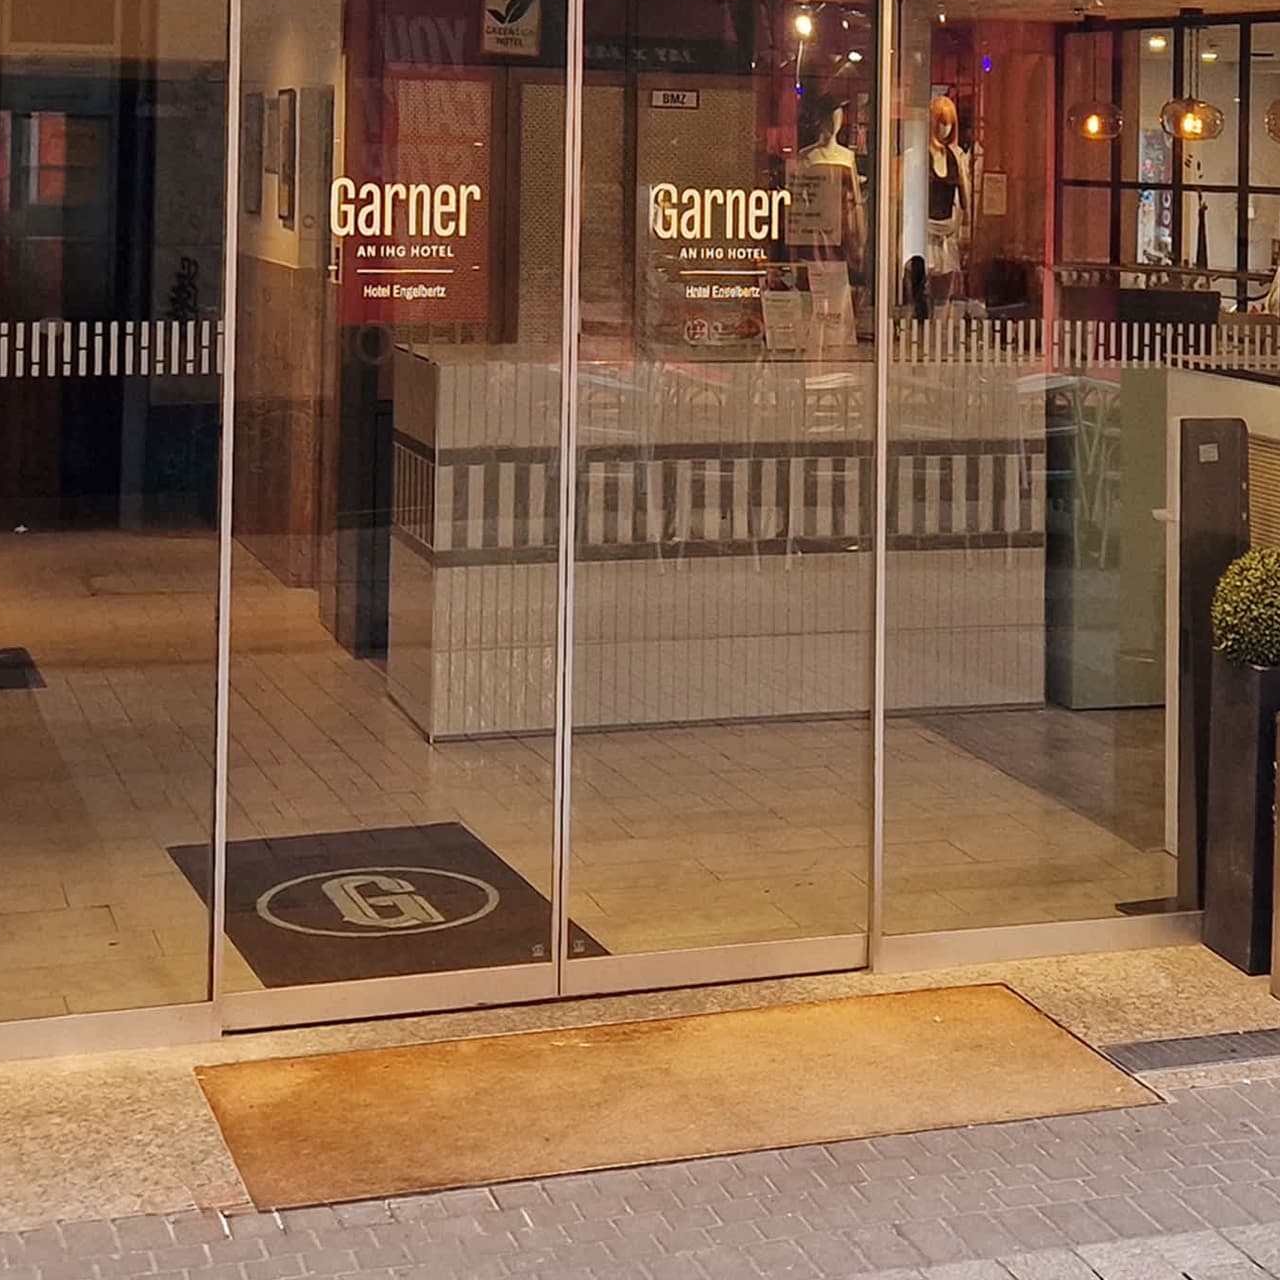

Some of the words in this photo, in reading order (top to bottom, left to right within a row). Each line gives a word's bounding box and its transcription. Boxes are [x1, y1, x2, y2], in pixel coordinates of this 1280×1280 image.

[662, 93, 687, 105] BMZ
[330, 177, 481, 236] Garner
[652, 183, 792, 240] Garner
[356, 245, 376, 257] AN
[380, 245, 406, 257] IHG
[411, 245, 454, 257] HOTEL
[679, 247, 697, 259] AN
[700, 247, 724, 259] IHG
[728, 247, 768, 259] HOTEL
[363, 285, 390, 298] Hotel
[393, 285, 446, 300] Engelbertz
[322, 875, 445, 928] G
